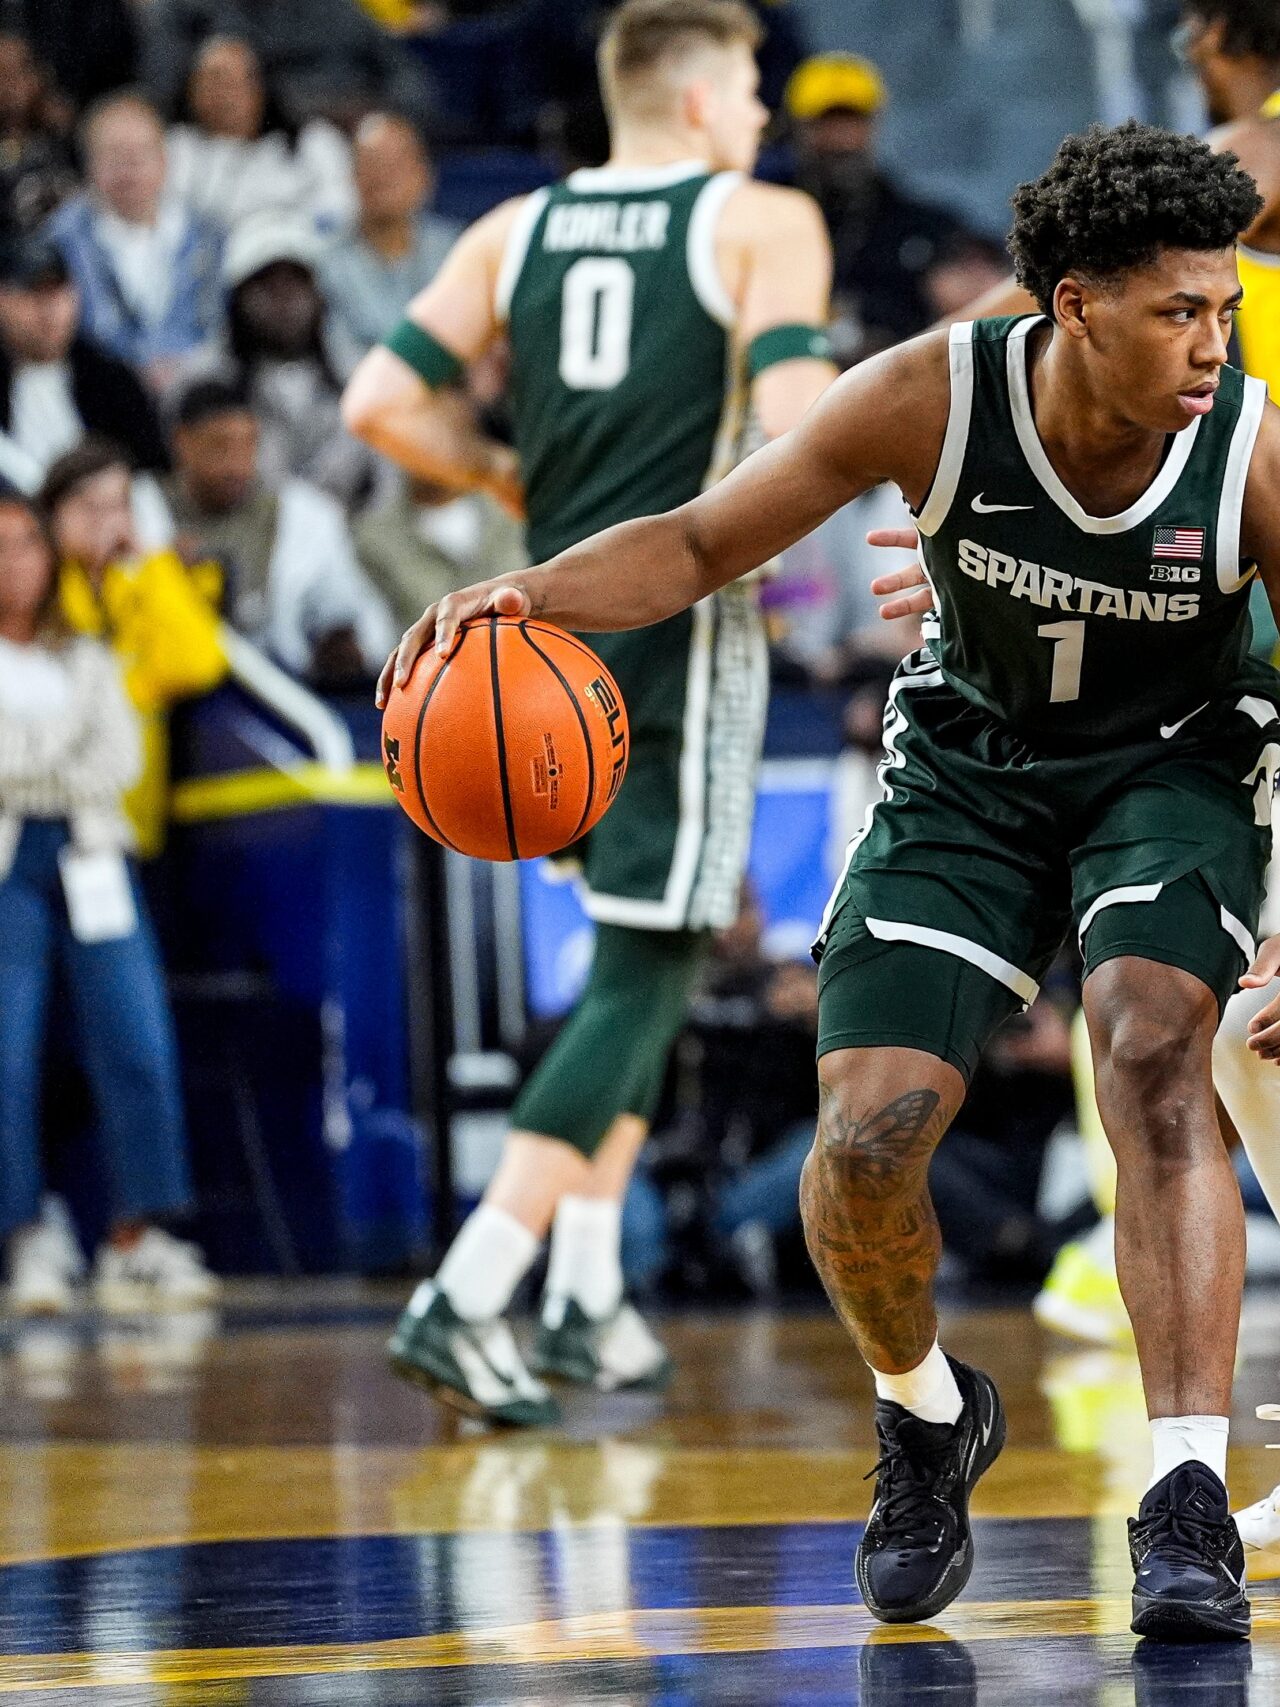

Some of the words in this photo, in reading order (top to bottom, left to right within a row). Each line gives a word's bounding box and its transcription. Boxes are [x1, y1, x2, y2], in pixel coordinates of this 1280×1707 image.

[558, 256, 636, 391] 0
[958, 539, 1201, 622] SPARTANS
[1037, 620, 1086, 703] 1
[590, 675, 626, 803] ELITE
